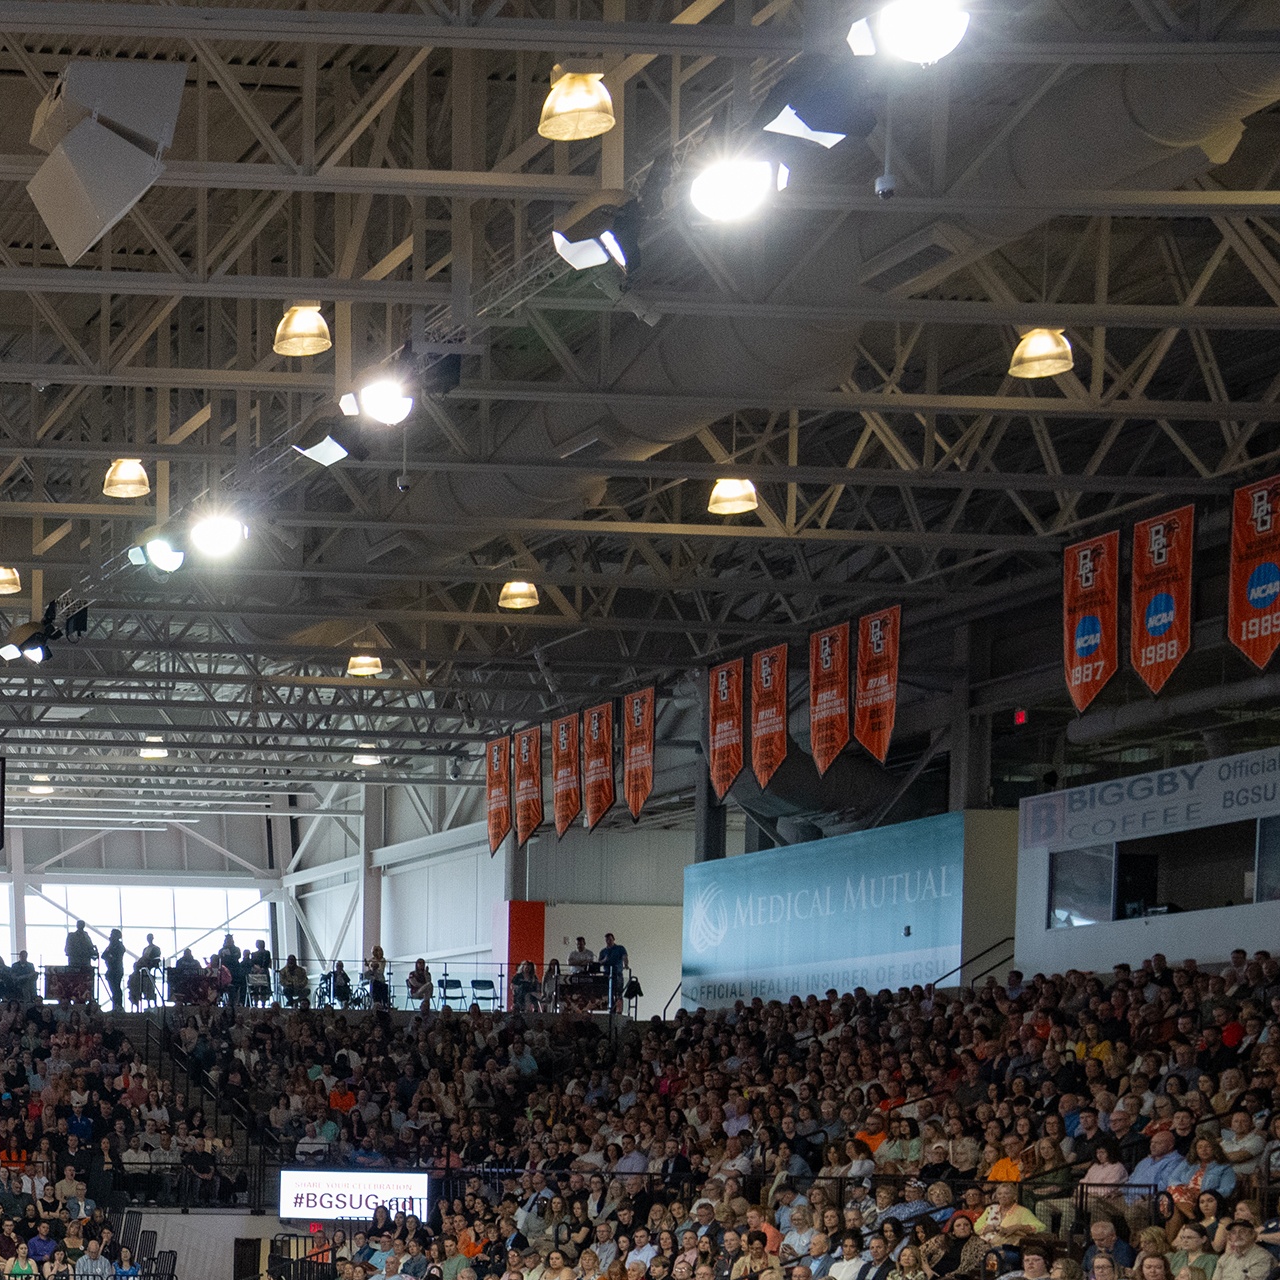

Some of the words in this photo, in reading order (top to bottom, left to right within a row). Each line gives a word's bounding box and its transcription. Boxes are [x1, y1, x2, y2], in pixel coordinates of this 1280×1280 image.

[1249, 580, 1280, 600] NCAA
[1148, 611, 1174, 629] NCAA
[1076, 633, 1100, 648] NCAA
[1141, 640, 1178, 667] 1988
[1072, 661, 1105, 686] 1987
[1218, 756, 1280, 781] Official
[1067, 765, 1205, 813] BIGGBY
[1222, 783, 1277, 809] BGSU
[1068, 802, 1202, 841] COFFEE
[733, 886, 835, 929] MEDICAL
[842, 865, 953, 911] MUTUAL
[690, 982, 744, 1001] OFFICIAL
[750, 976, 801, 995] HEALTH
[806, 969, 869, 990] INSURER
[875, 966, 895, 982] OF
[902, 959, 947, 980] BGSU
